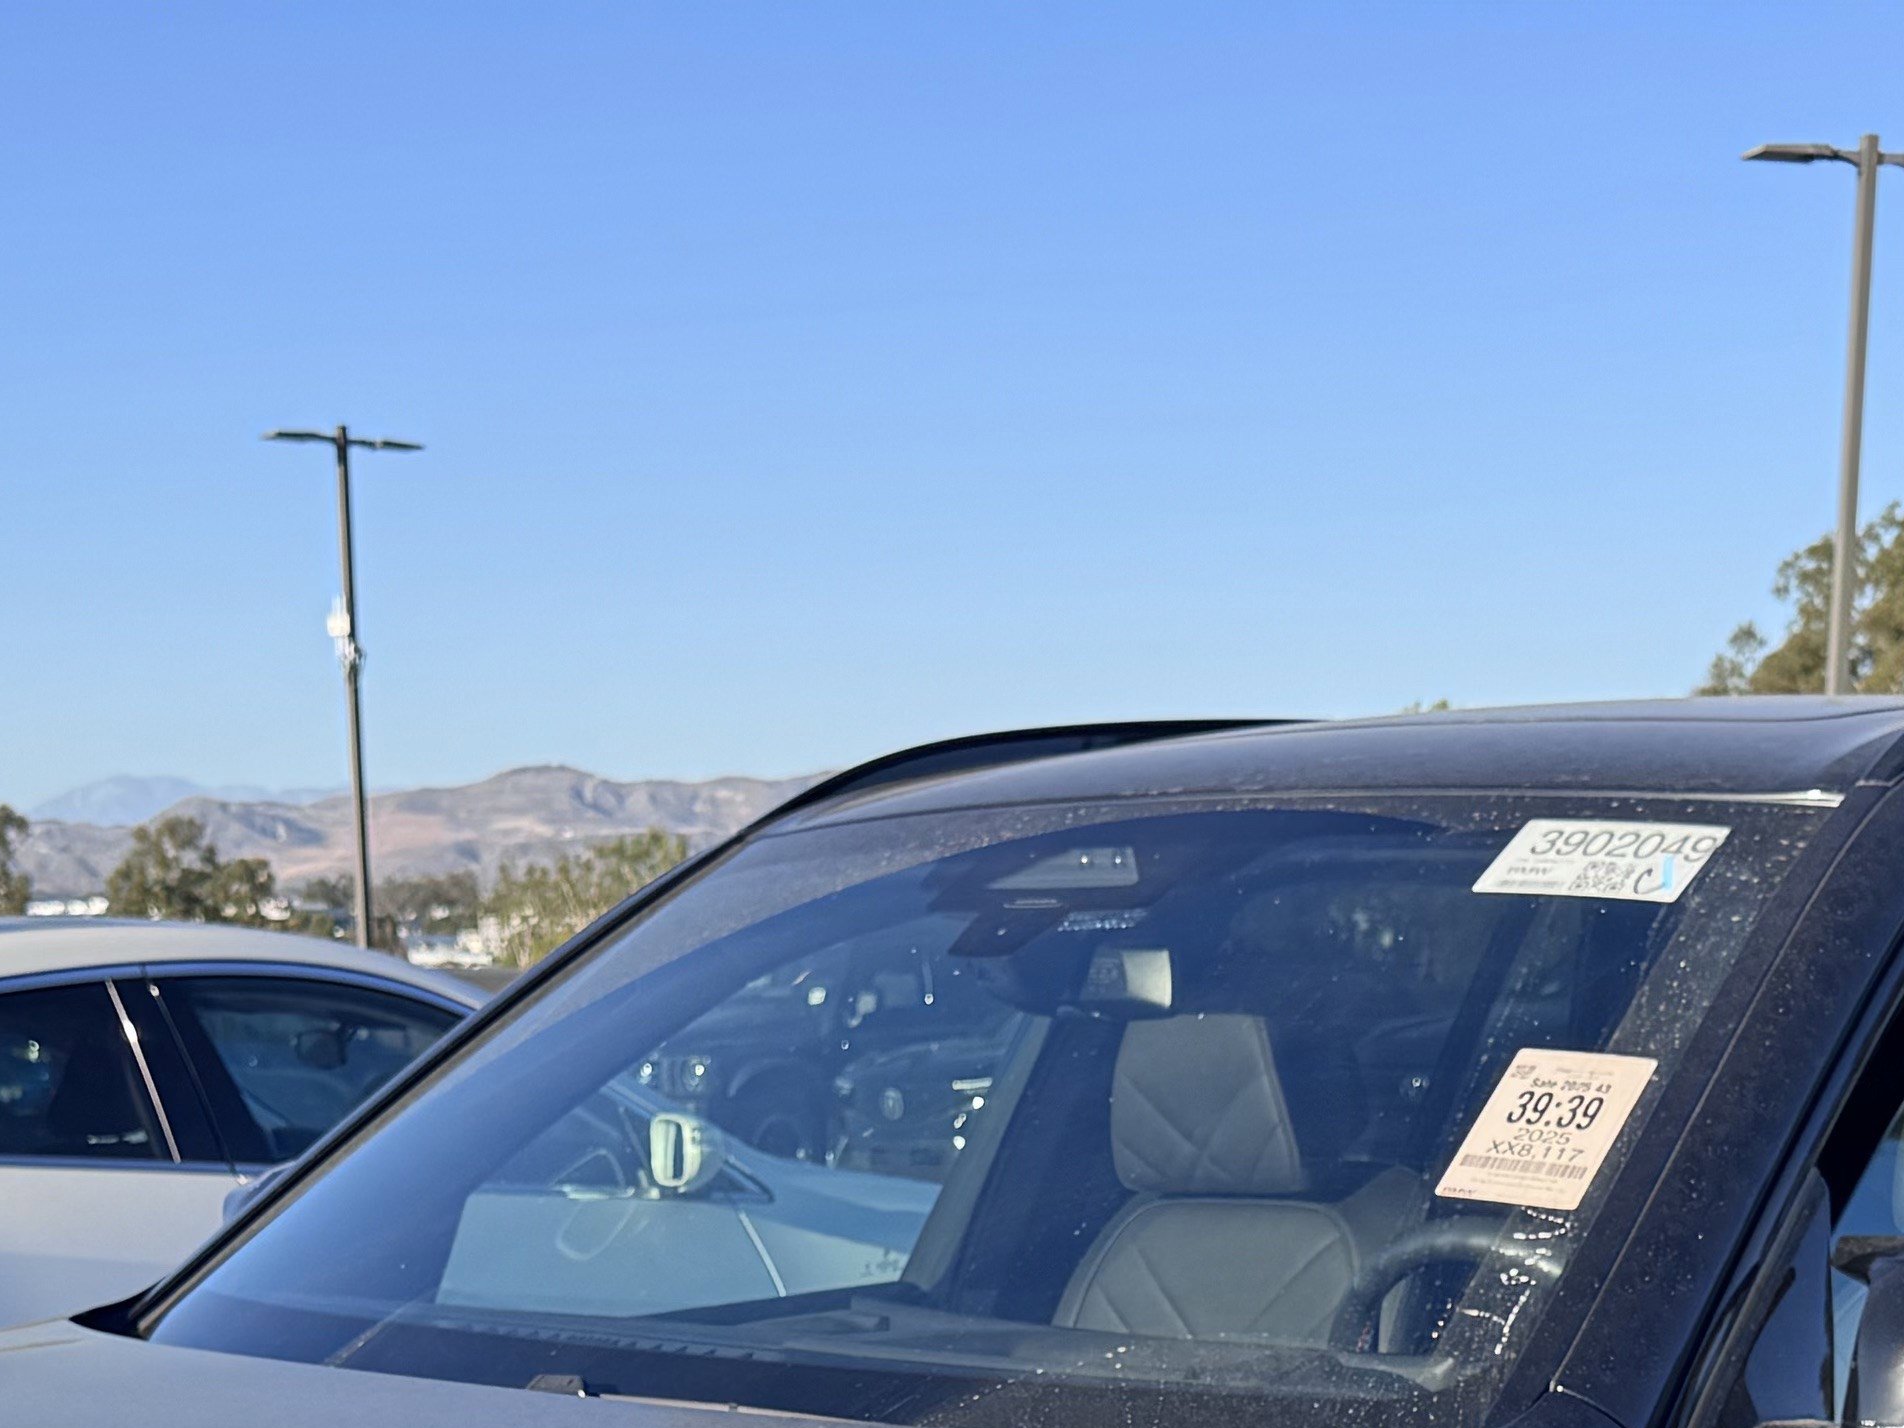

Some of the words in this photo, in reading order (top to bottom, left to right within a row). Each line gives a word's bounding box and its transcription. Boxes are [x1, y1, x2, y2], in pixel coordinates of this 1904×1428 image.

[1530, 829, 1719, 863] 3902049
[1506, 1090, 1605, 1131] 39:39
[1513, 1127, 1573, 1146] 2025
